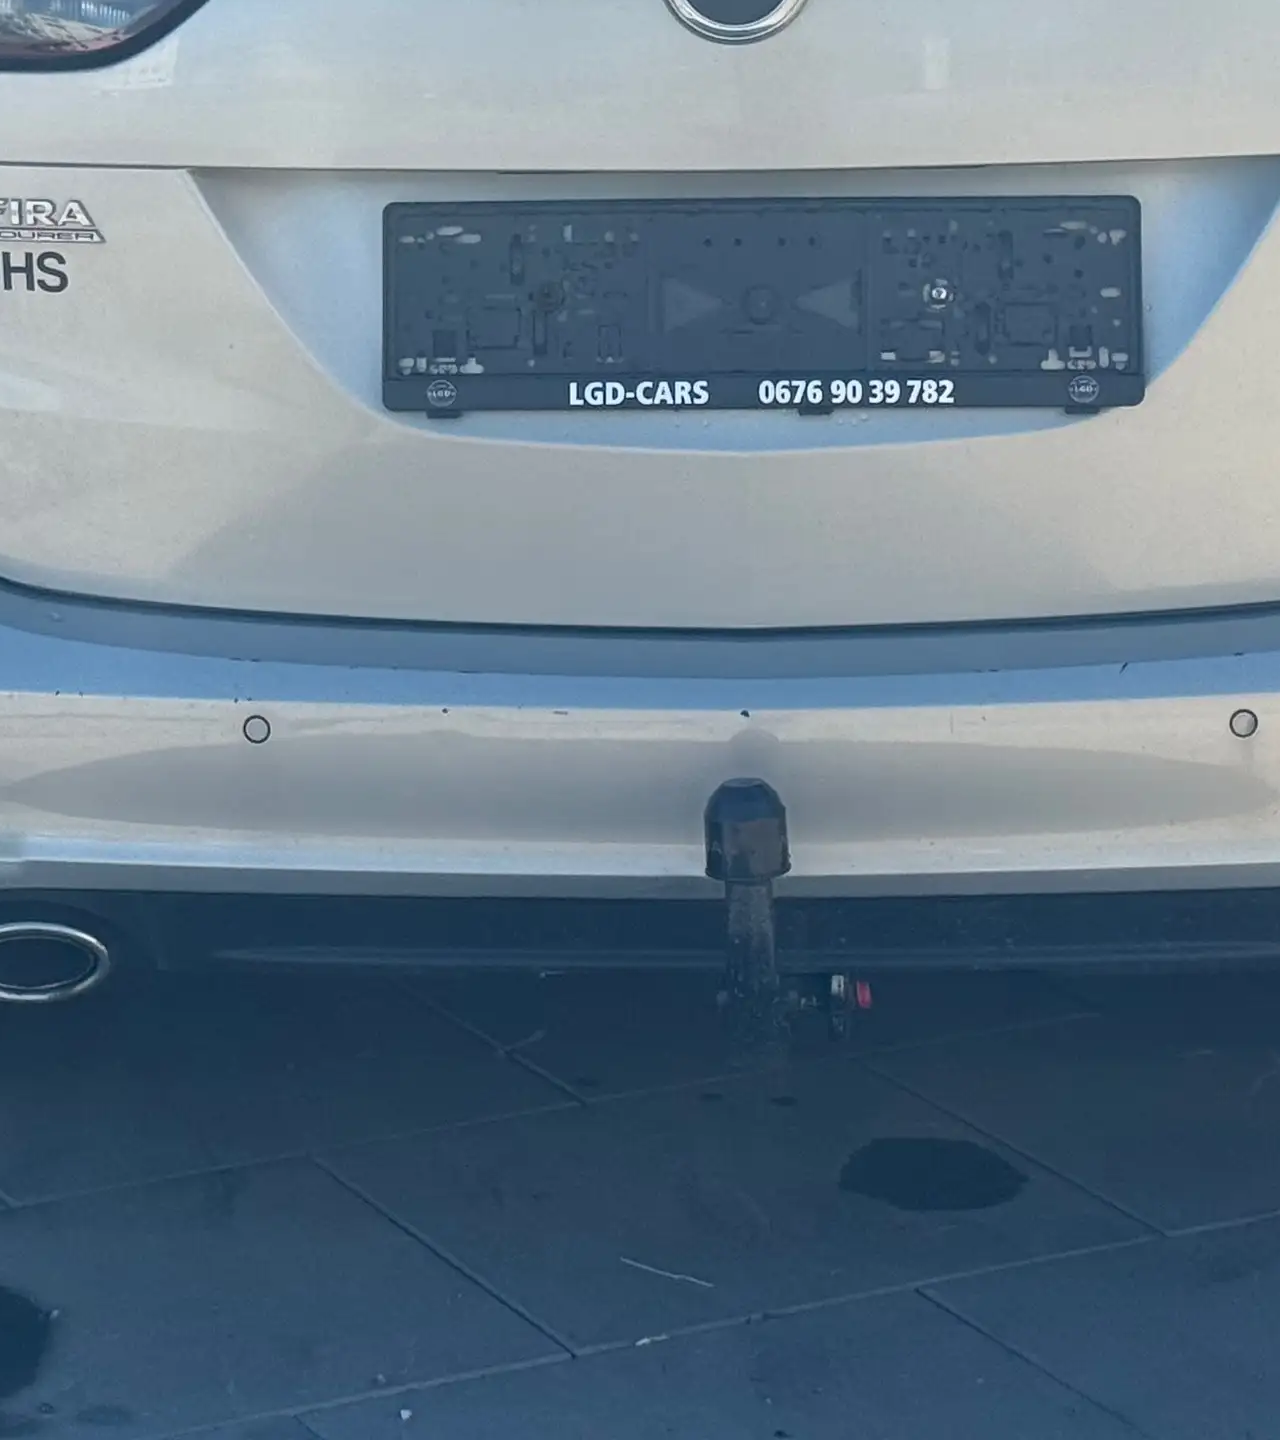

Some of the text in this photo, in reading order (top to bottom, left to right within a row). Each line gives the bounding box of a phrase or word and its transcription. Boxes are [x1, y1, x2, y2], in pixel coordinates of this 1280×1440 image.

[568, 379, 955, 406] LGD-CARS 0676 90 39 782
